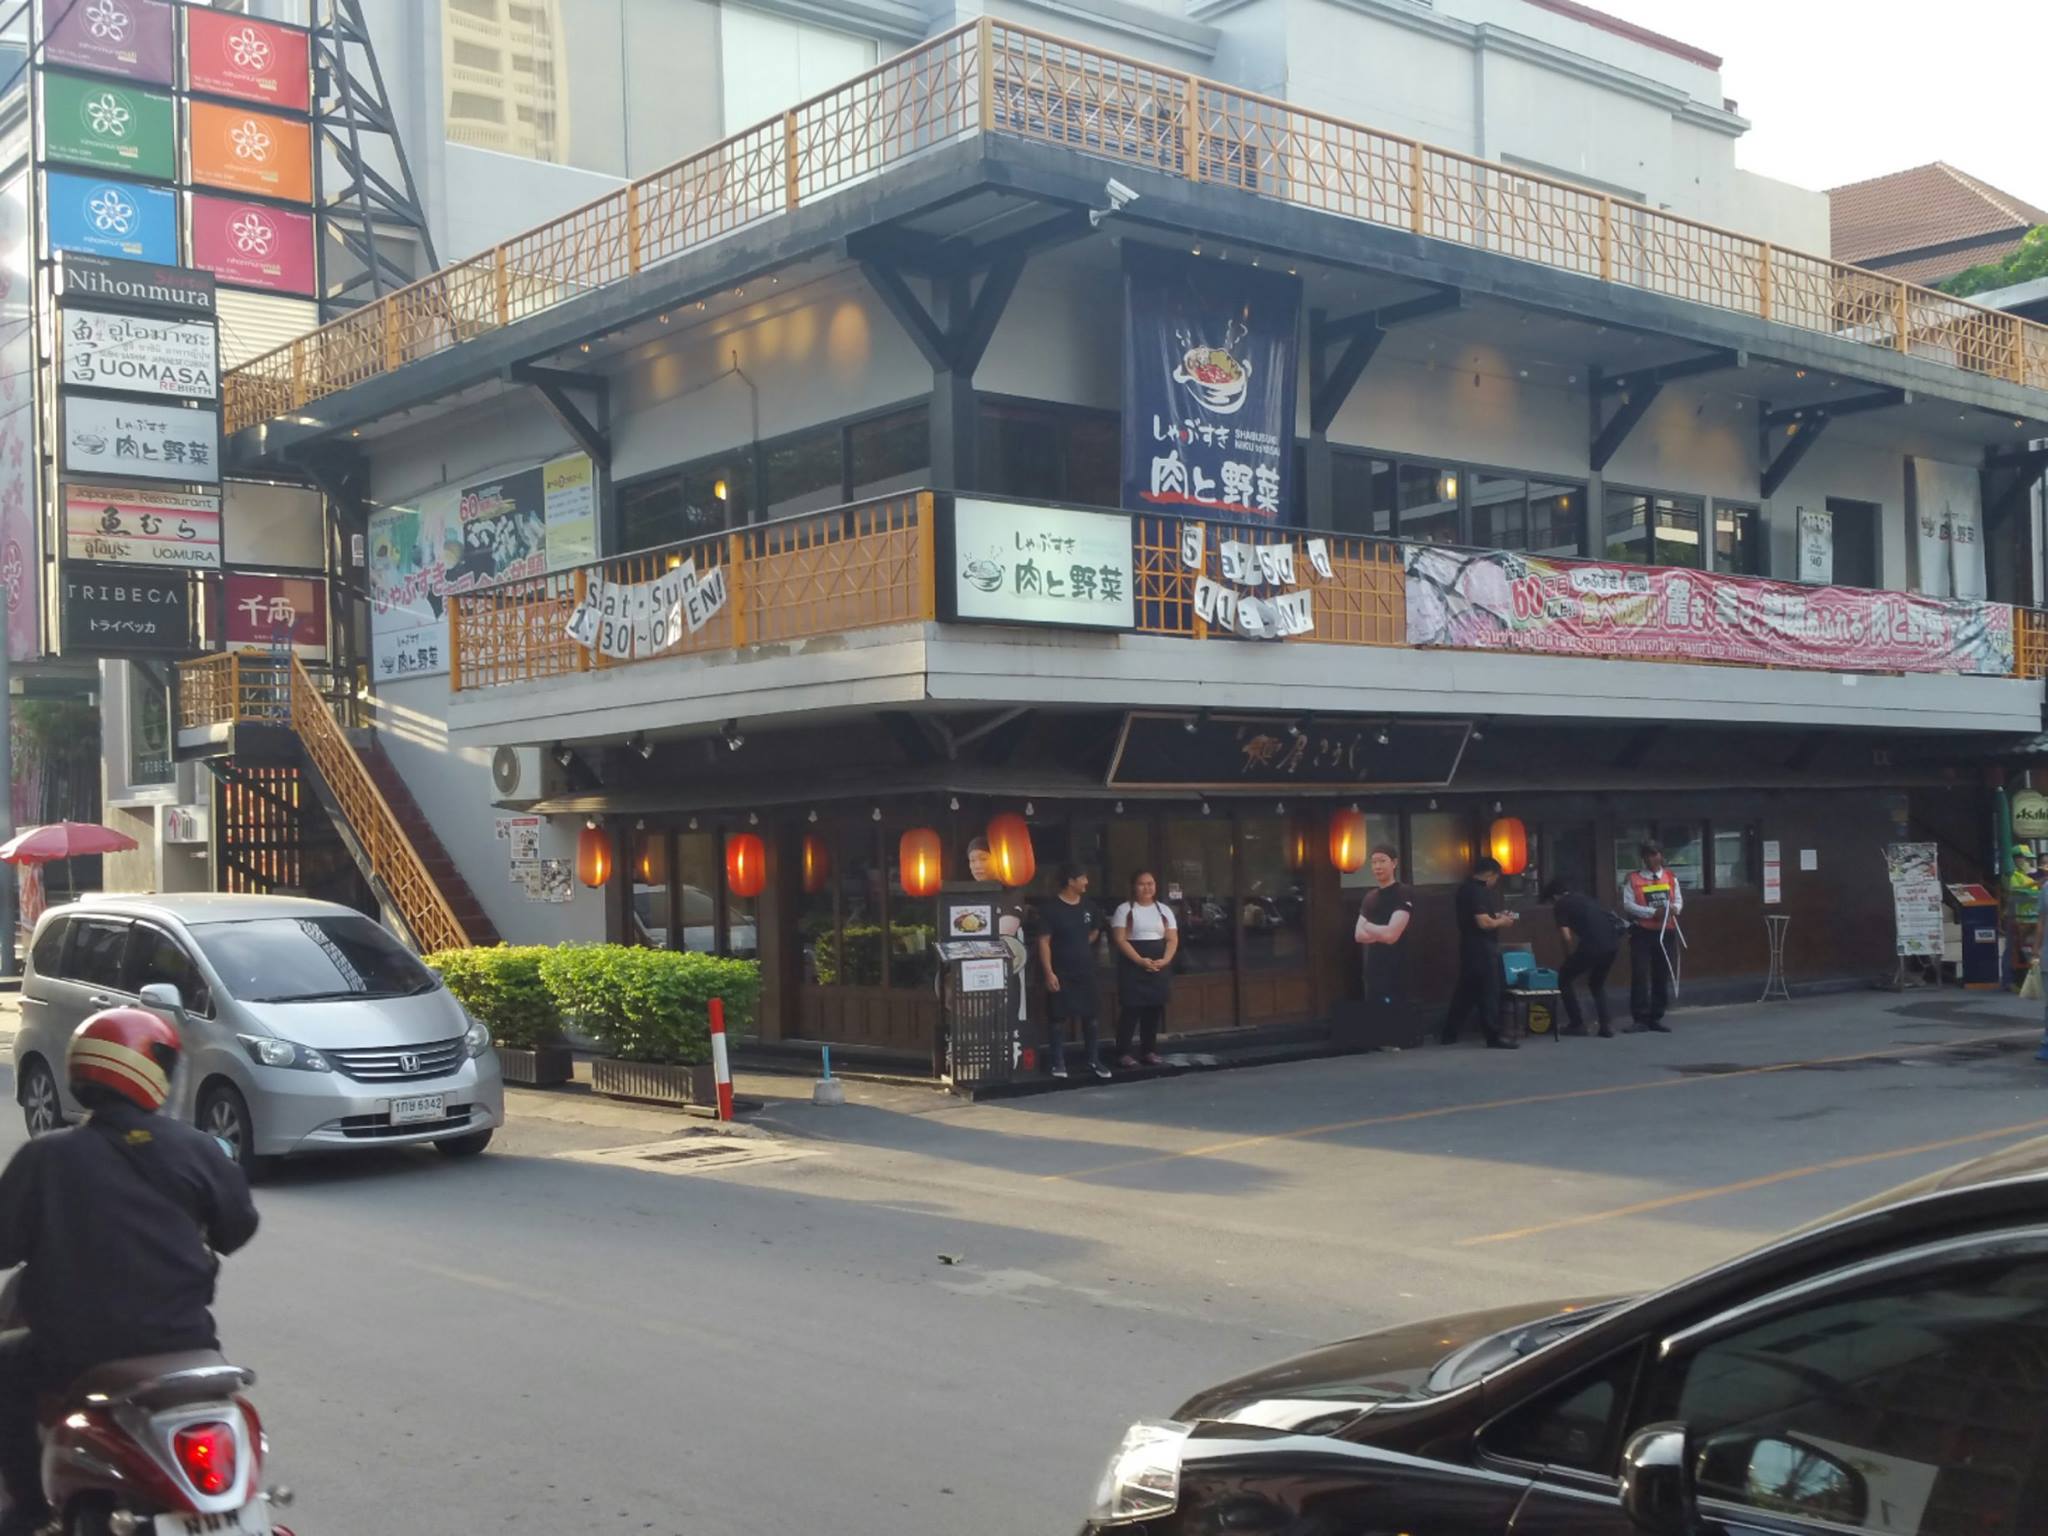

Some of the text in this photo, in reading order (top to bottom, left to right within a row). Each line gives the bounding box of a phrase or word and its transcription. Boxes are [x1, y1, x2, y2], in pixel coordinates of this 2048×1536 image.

[67, 268, 210, 307] Nihonmura
[100, 358, 210, 386] UOMASA
[160, 381, 212, 395] REBIRTH
[1153, 414, 1231, 448] しゃぶすき
[116, 435, 209, 465] 肉と野菜
[1151, 449, 1280, 514] 肉と野菜
[76, 487, 212, 508] Japanese Restaurant
[153, 547, 216, 562] UOMURA
[1015, 530, 1077, 555] しゃぶすき
[68, 584, 179, 604] TRIBECA
[1015, 557, 1123, 603] 肉と野菜
